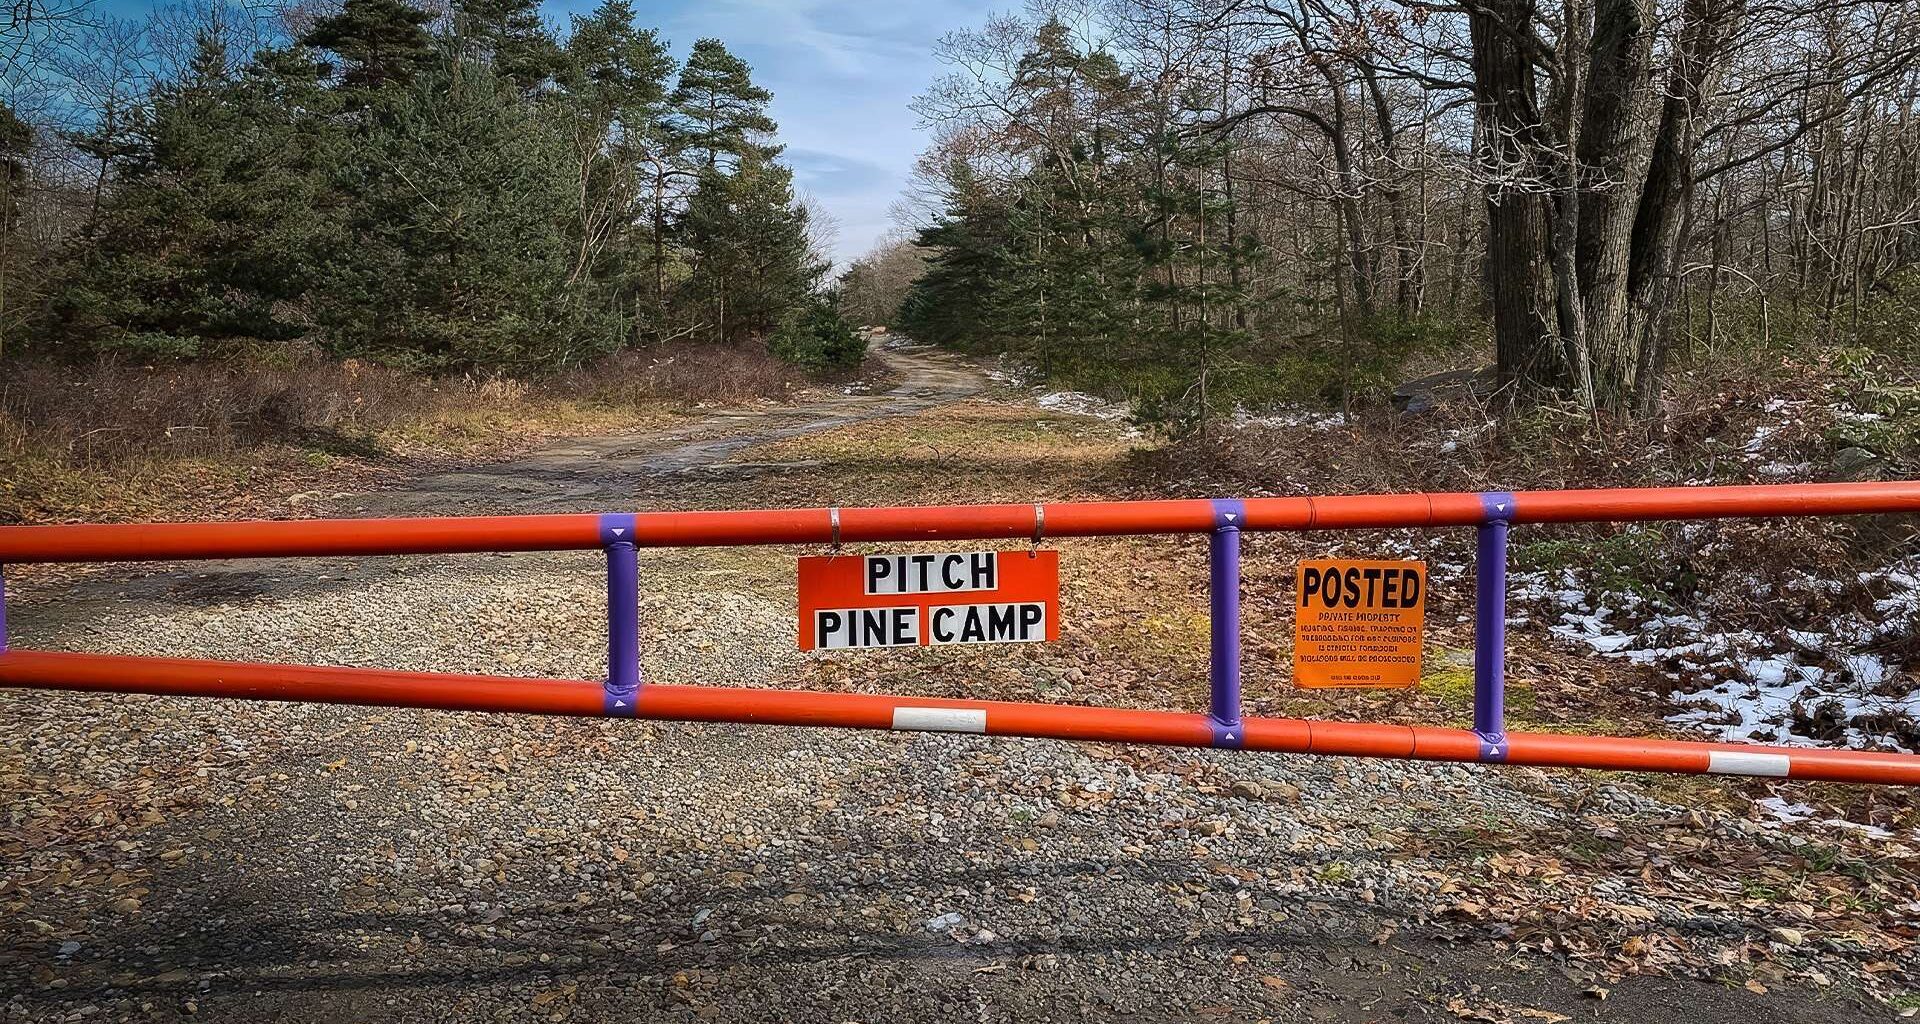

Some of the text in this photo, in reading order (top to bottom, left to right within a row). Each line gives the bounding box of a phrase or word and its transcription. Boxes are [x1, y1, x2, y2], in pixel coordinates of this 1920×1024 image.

[868, 552, 995, 593] PITCH
[1302, 567, 1420, 608] POSTED
[818, 604, 1043, 649] PINE CAMP
